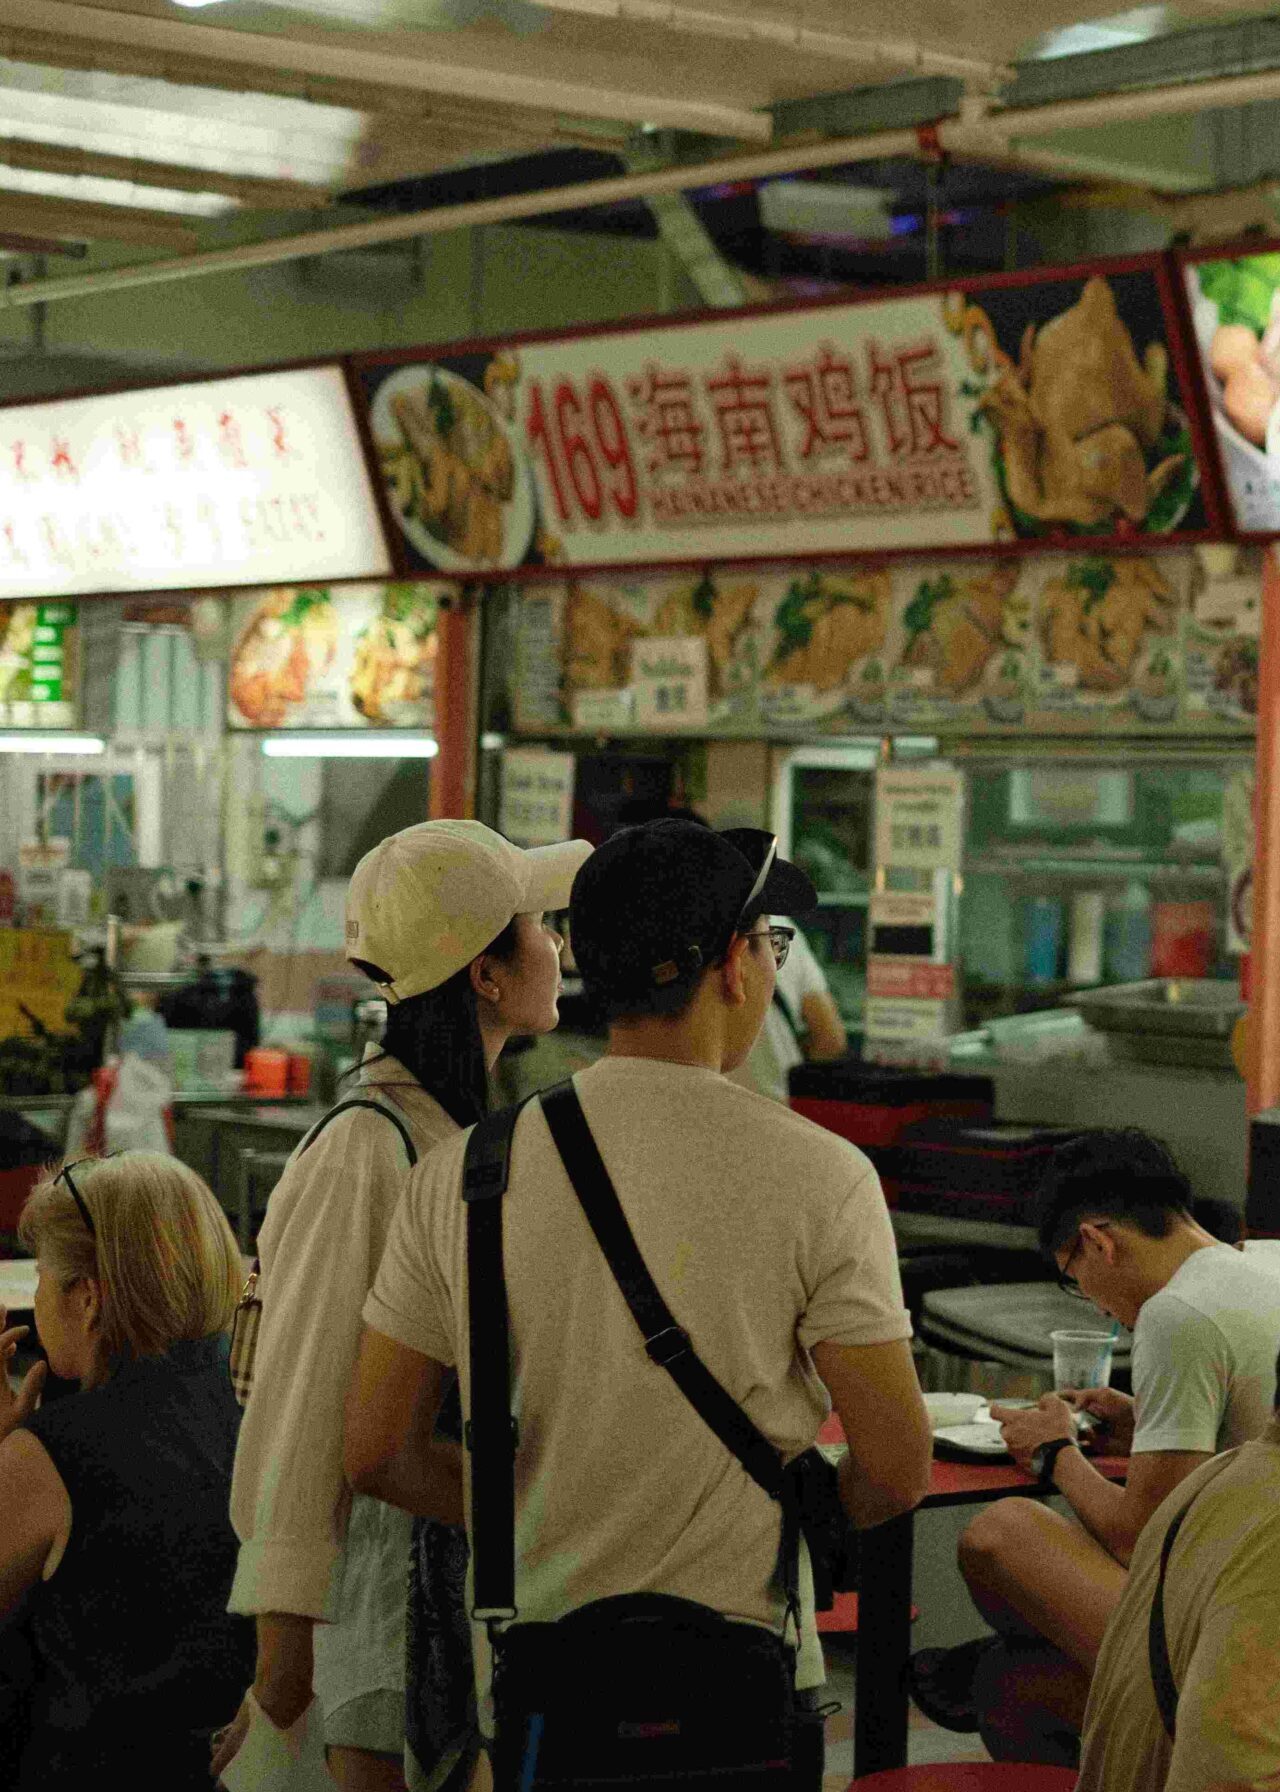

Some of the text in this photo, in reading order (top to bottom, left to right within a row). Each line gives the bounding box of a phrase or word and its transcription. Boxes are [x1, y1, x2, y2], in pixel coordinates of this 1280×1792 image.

[527, 338, 960, 521] 169 海南鸡饭
